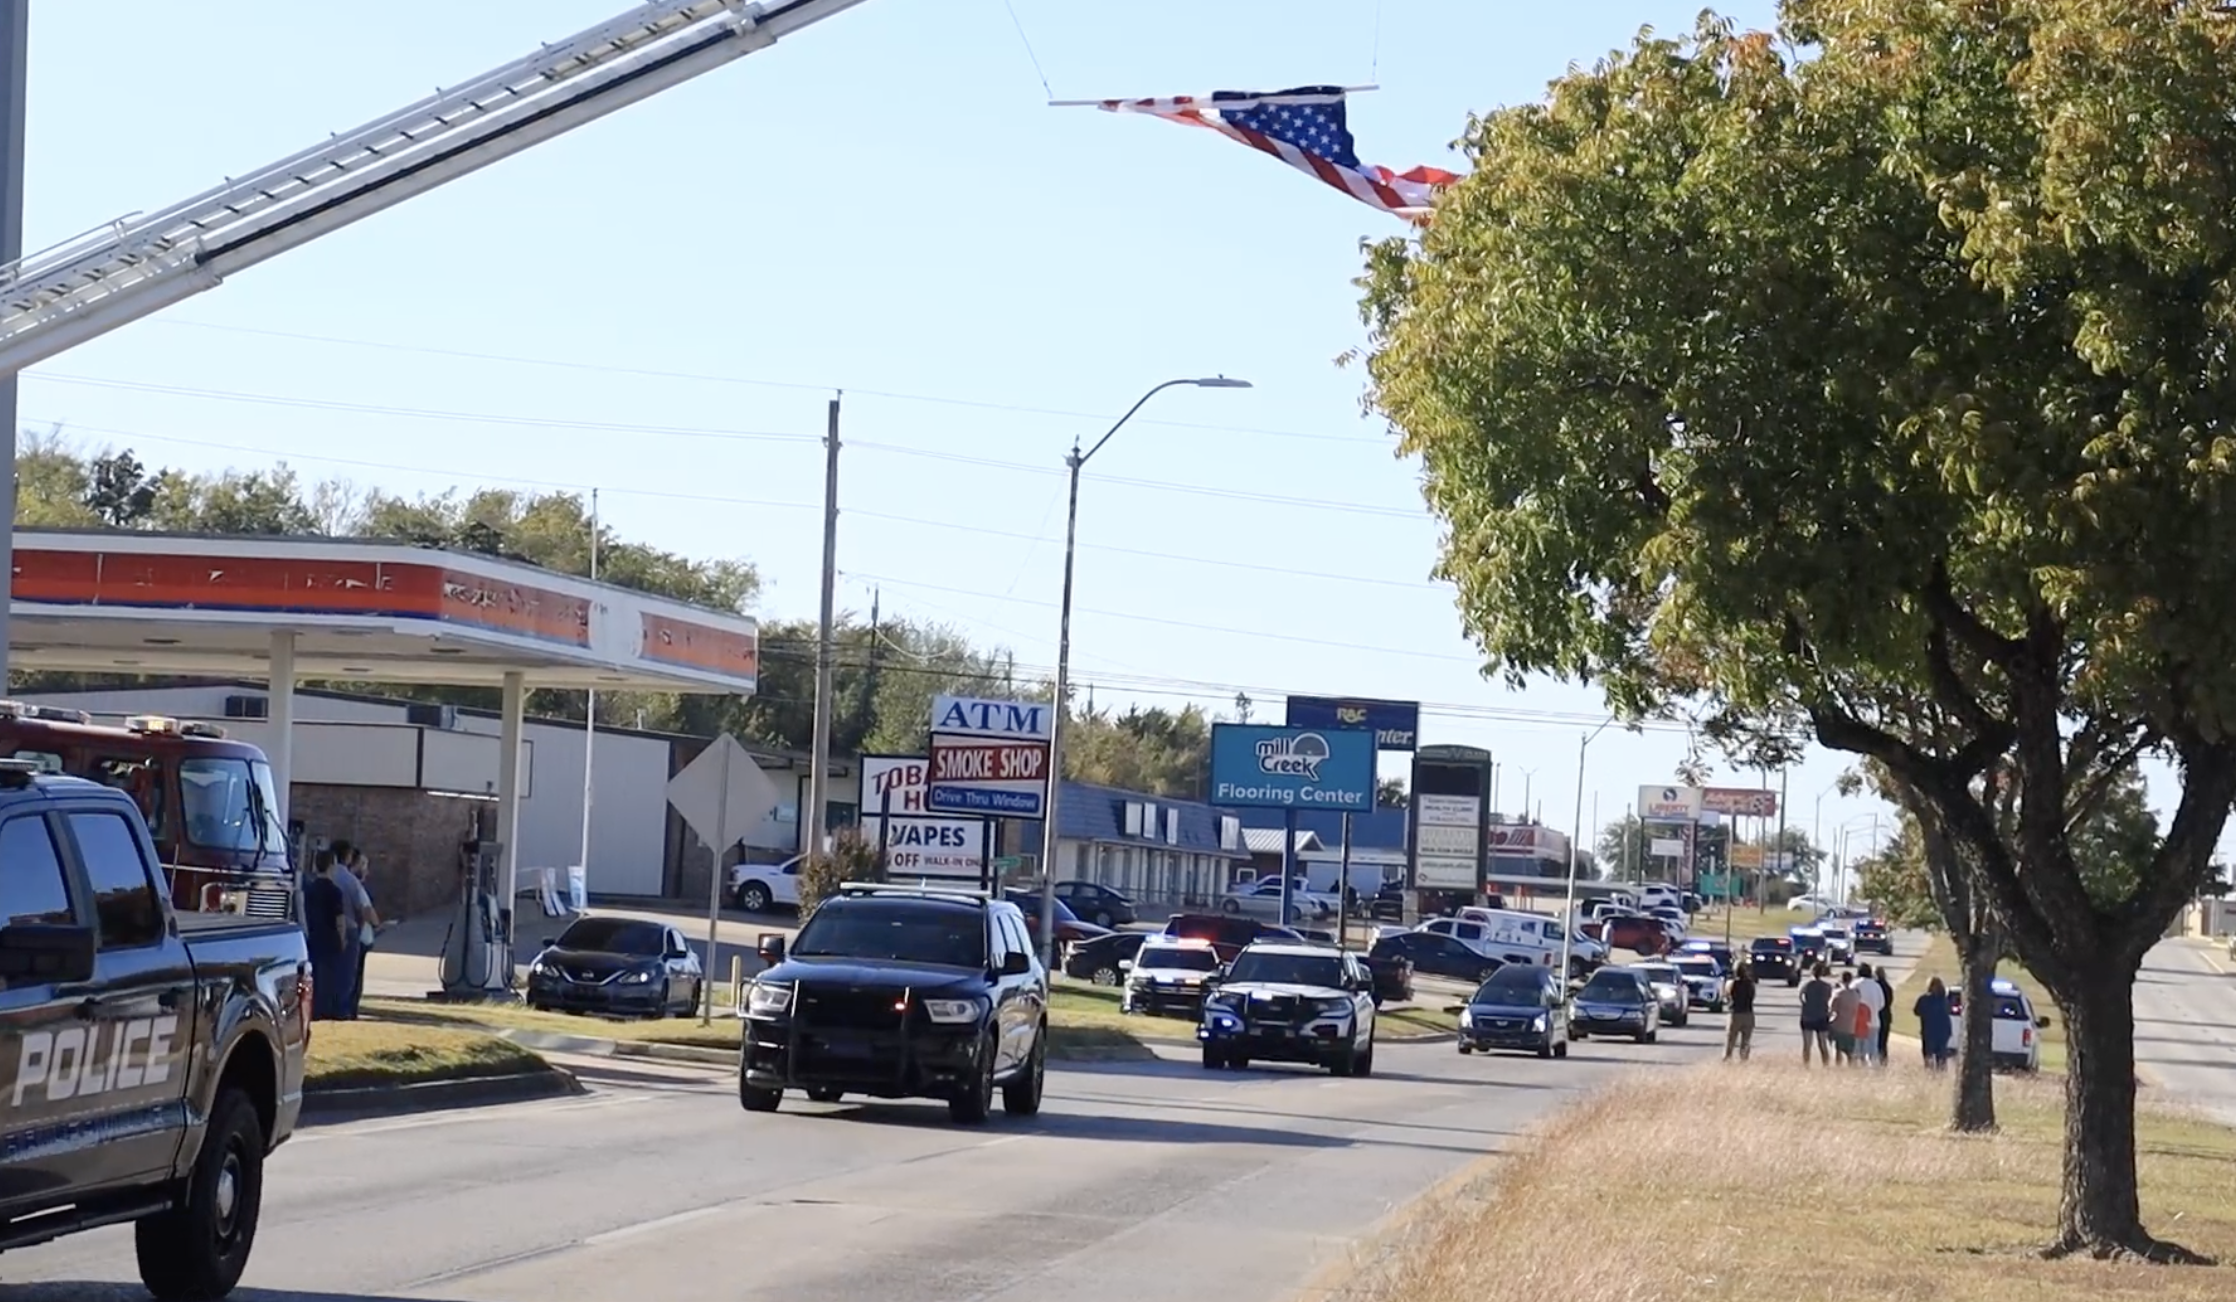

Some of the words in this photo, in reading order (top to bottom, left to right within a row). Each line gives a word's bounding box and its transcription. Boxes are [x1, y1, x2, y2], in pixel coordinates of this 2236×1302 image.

[939, 702, 1043, 734] ATM
[1258, 738, 1291, 756] mill
[936, 748, 994, 778] SMOKE
[1000, 748, 1042, 778] SHOP
[1261, 755, 1320, 782] Creek
[934, 789, 963, 803] Drive
[965, 791, 989, 806] Thru
[992, 794, 1038, 808] Window
[1218, 783, 1294, 803] Flooring
[1301, 786, 1363, 803] Center
[890, 825, 965, 847] VAPES
[895, 854, 919, 867] OFF
[12, 1015, 177, 1107] POLICE
